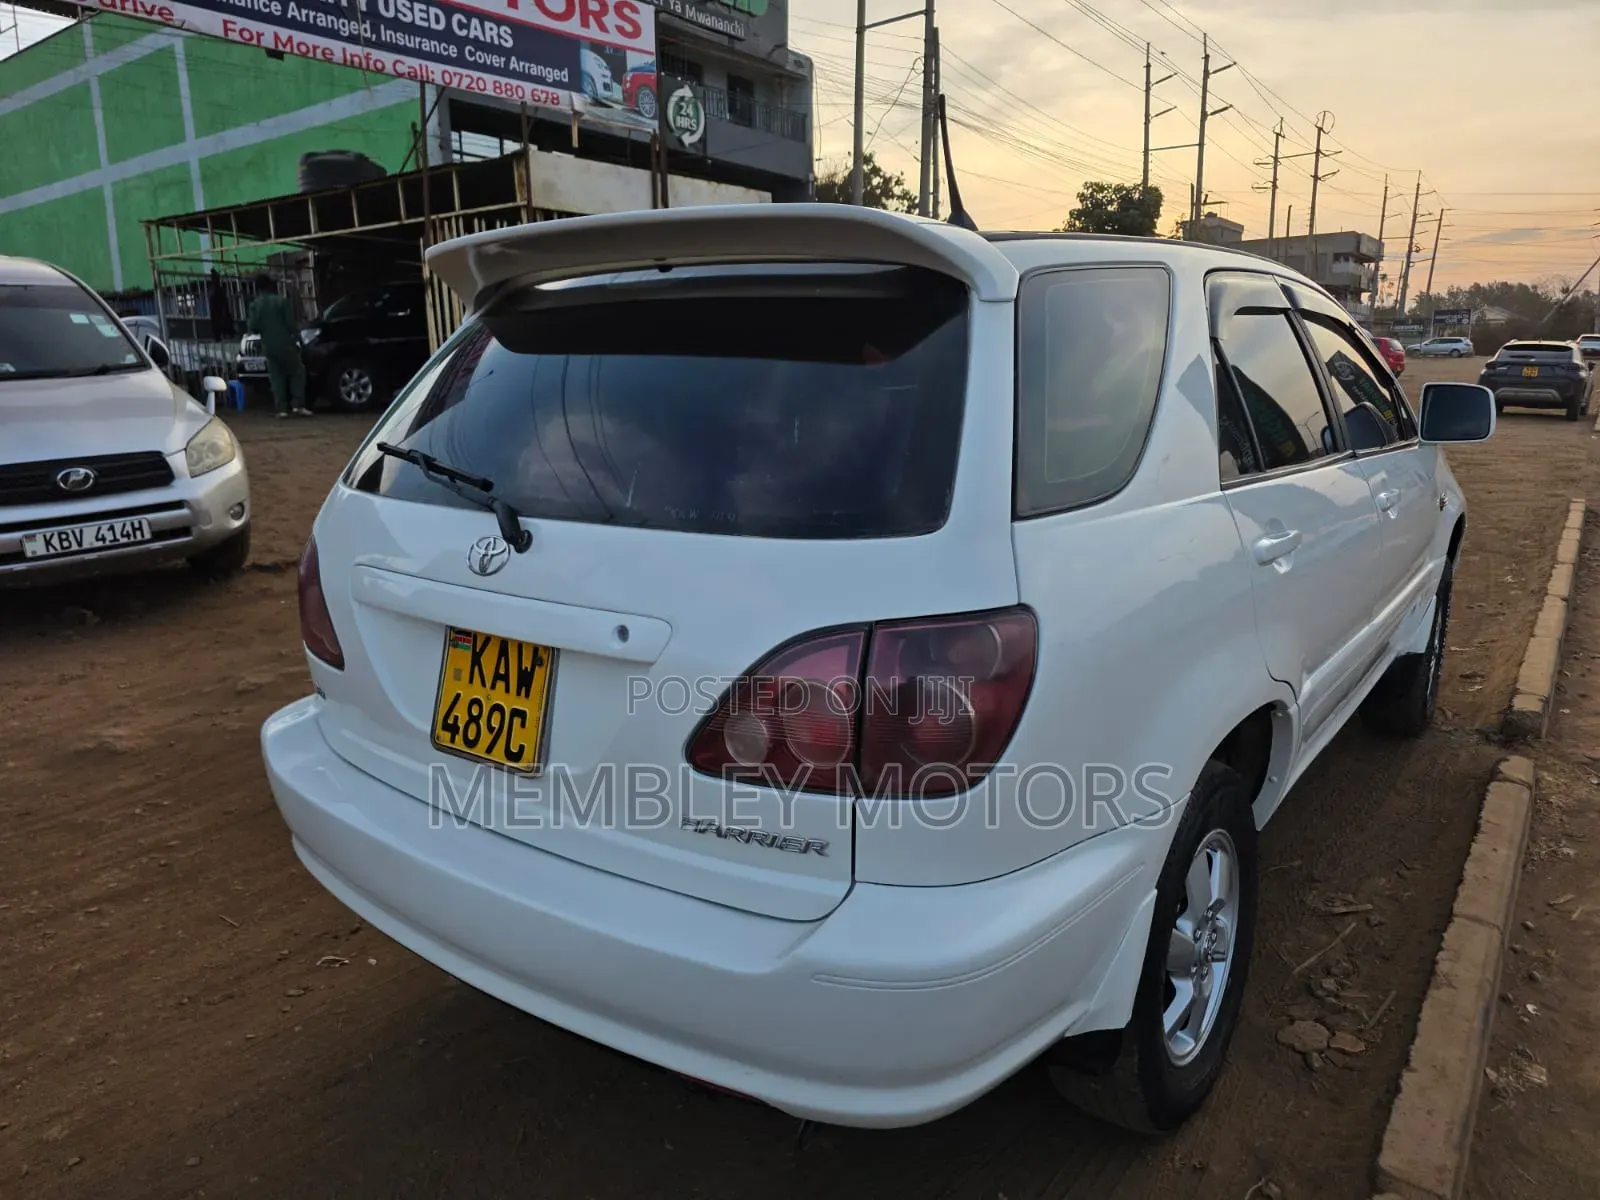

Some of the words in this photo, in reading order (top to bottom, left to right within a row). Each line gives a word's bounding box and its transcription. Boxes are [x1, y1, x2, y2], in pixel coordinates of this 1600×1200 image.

[378, 0, 446, 30] USED
[452, 13, 514, 48] CARS
[506, 0, 642, 40] ORS
[685, 4, 744, 36] Mwananchi
[222, 19, 264, 47] For
[273, 31, 335, 61] More
[342, 48, 386, 73] Info
[392, 59, 436, 84] Call:
[441, 69, 487, 92] 0720
[492, 80, 525, 100] 880
[530, 88, 561, 106] 678
[380, 23, 458, 58] Insurance
[464, 40, 506, 68] Cover
[509, 56, 569, 82] Arranged
[675, 116, 697, 131] HRS
[679, 102, 693, 116] 24
[43, 528, 84, 553] KBV
[94, 519, 145, 545] 414H
[468, 631, 540, 699] KAW
[441, 692, 529, 763] 489C
[679, 815, 831, 857] HARRIER
